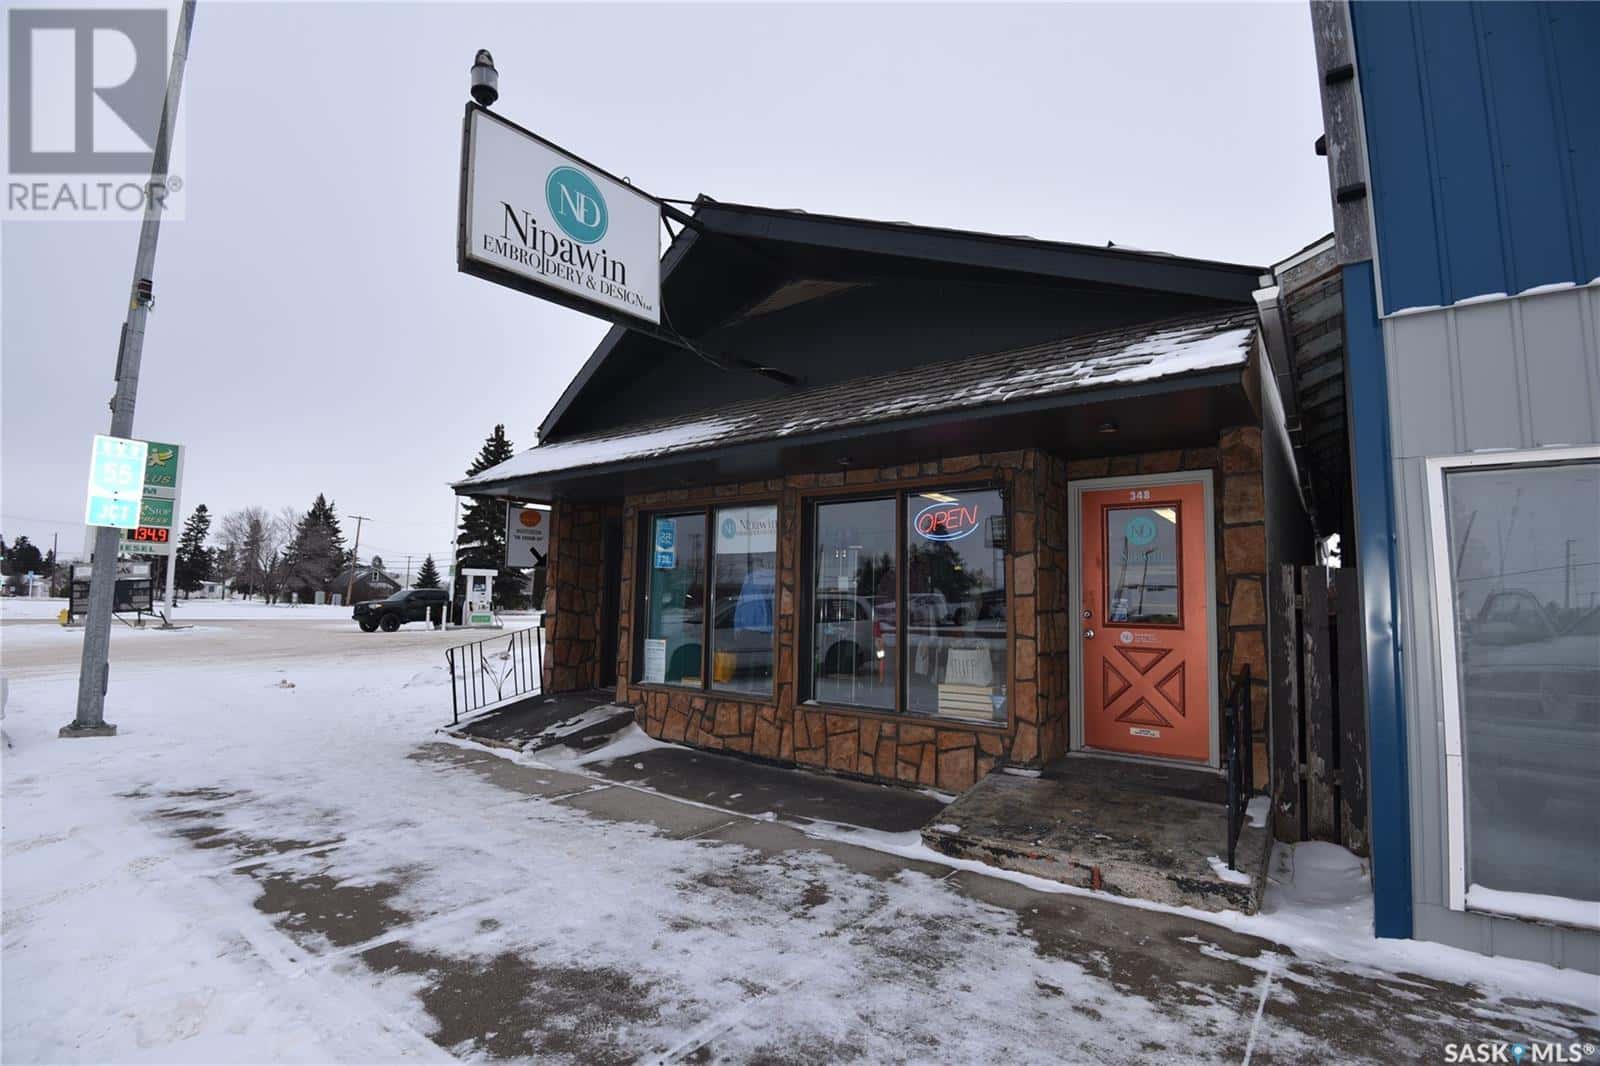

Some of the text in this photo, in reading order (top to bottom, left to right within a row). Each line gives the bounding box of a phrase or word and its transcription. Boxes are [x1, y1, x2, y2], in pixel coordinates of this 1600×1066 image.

[499, 201, 626, 286] Nipawin
[483, 234, 582, 285] EMBROIDERY
[586, 275, 599, 290] &
[600, 280, 643, 308] DESIGN
[918, 504, 979, 534] OPEN
[1130, 489, 1151, 501] 348
